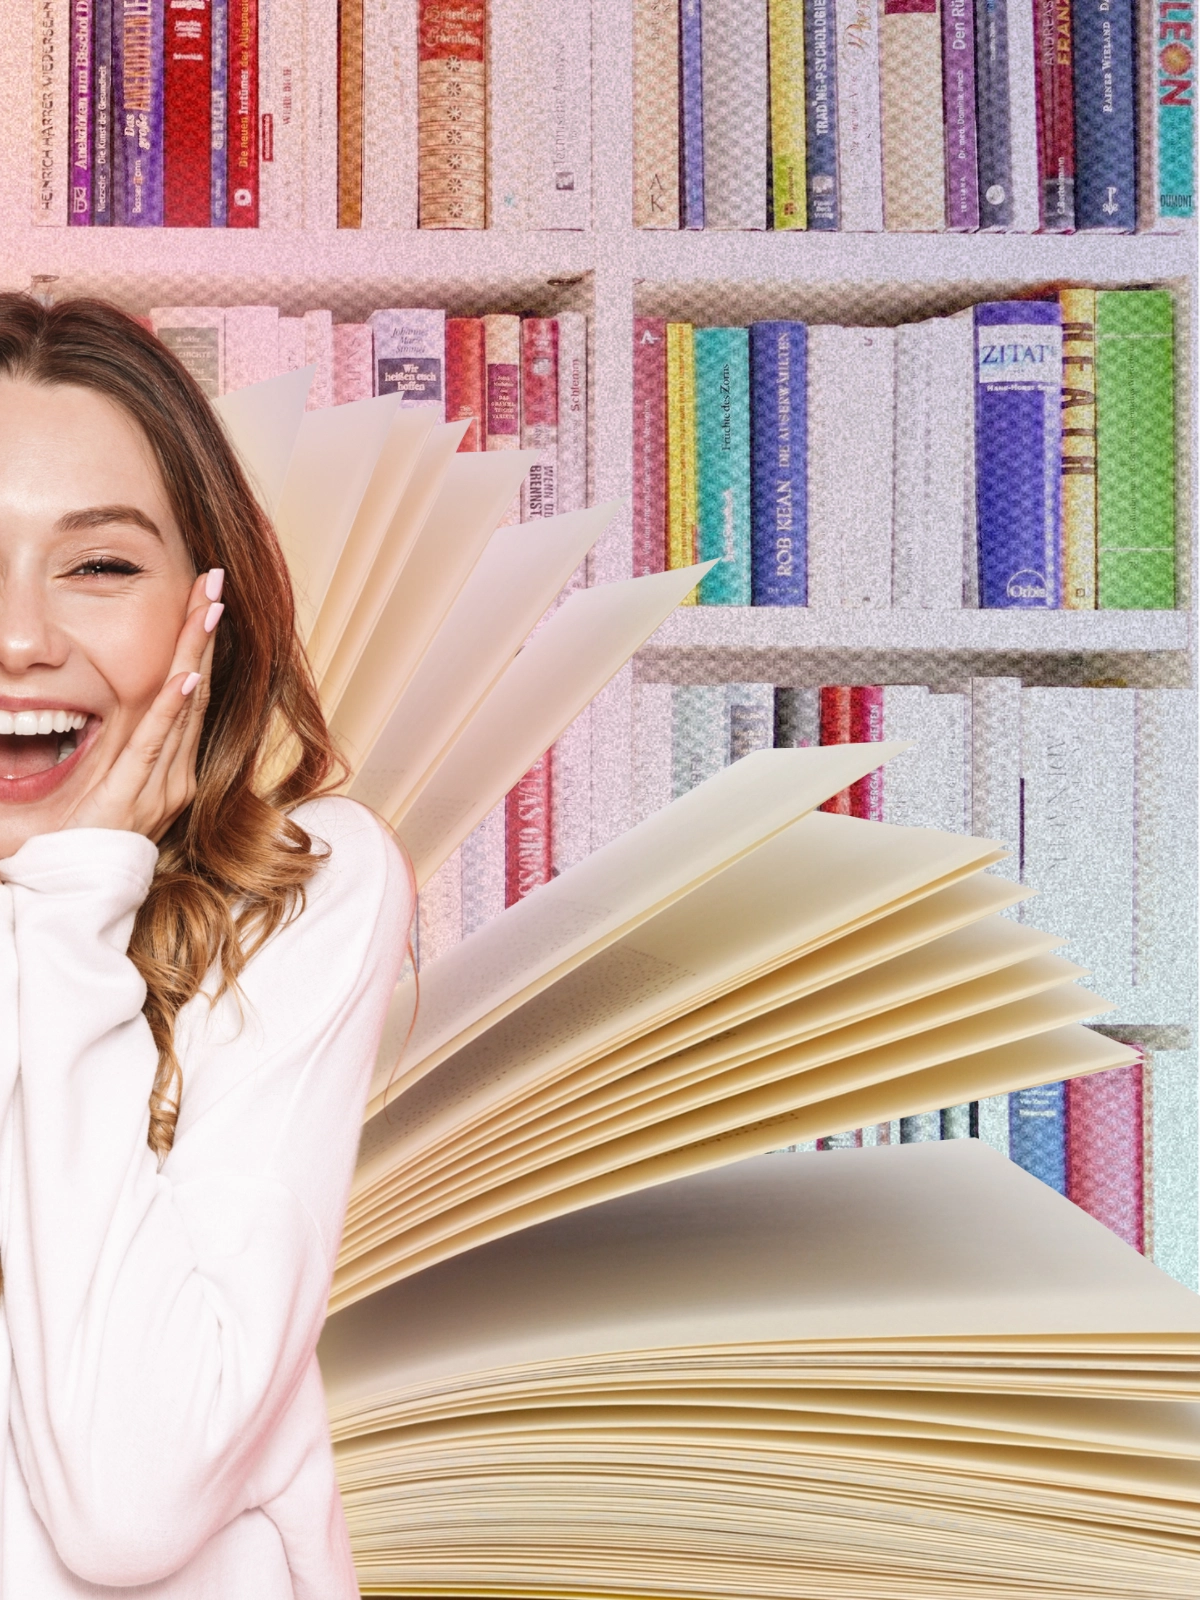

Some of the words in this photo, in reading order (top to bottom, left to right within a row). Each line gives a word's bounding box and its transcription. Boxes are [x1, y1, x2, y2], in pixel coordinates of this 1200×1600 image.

[74, 16, 88, 67] Bischof
[952, 22, 967, 50] Den
[1101, 21, 1112, 71] WIELAND
[123, 0, 151, 112] ANEKDOTENLE
[239, 50, 250, 67] der
[75, 70, 88, 94] um
[97, 66, 107, 110] Gesundheit
[238, 70, 250, 115] Irrtümer
[1102, 72, 1113, 112] RAINER
[41, 93, 55, 146] HARRER
[97, 112, 107, 125] der
[125, 114, 135, 136] Das
[136, 113, 150, 150] große
[240, 117, 250, 148] neuen
[74, 99, 88, 171] Anekdoten
[97, 127, 107, 150] Kunst
[97, 150, 106, 164] Die
[239, 150, 250, 168] Die
[41, 149, 54, 211] HEINRICH
[1159, 195, 1192, 207] DUMONT
[403, 364, 419, 373] Wir
[981, 344, 1057, 365] ZITAT
[384, 372, 412, 382] heißen
[397, 381, 426, 391] hoffen
[569, 358, 580, 412] Schlemm
[720, 364, 730, 394] Zorns
[720, 396, 731, 412] des
[778, 446, 790, 468] DIE
[776, 480, 792, 532] KEAN
[776, 537, 793, 577] ROB
[518, 826, 544, 902] GROSS
